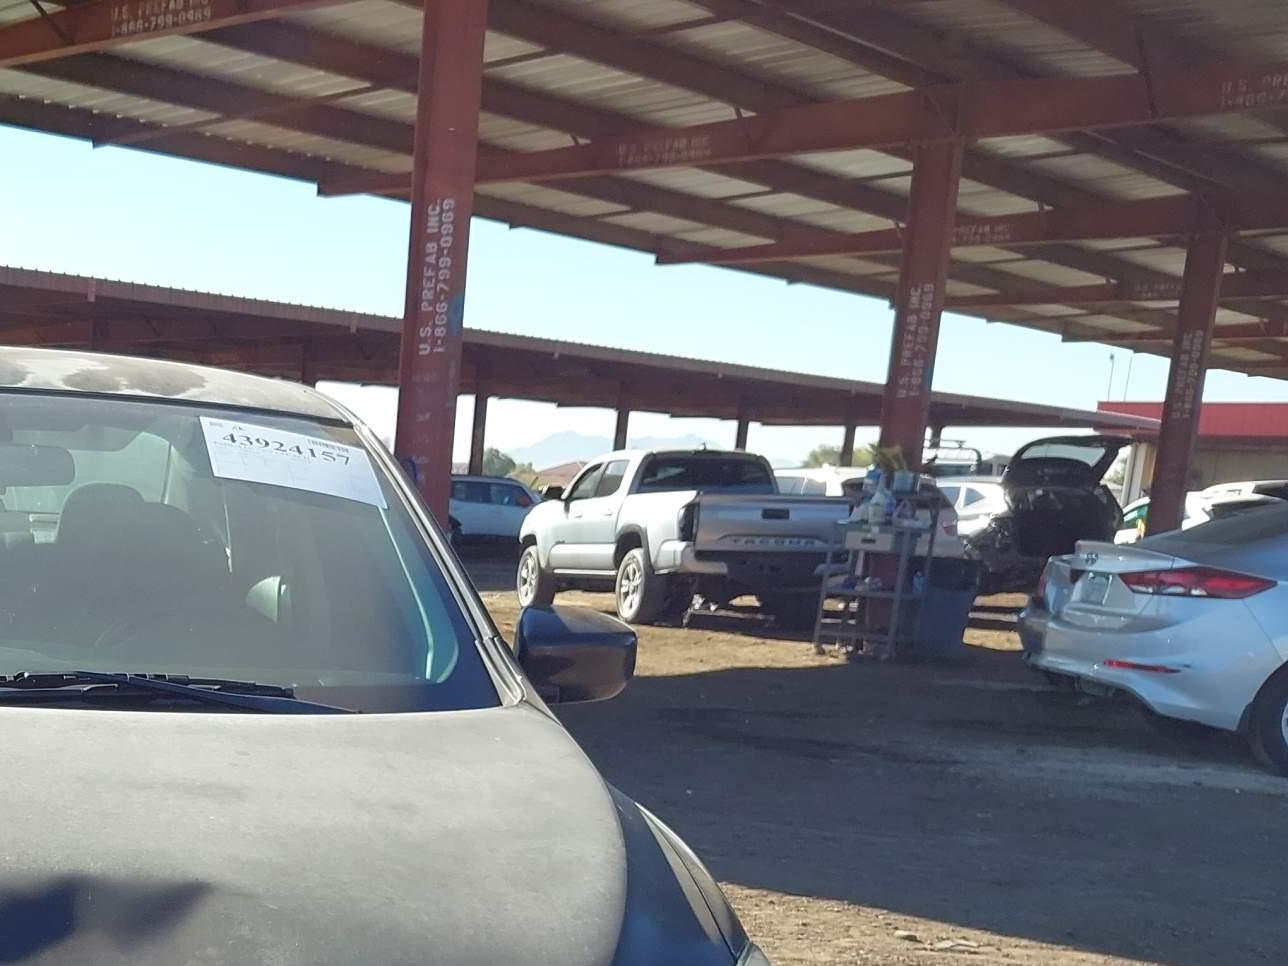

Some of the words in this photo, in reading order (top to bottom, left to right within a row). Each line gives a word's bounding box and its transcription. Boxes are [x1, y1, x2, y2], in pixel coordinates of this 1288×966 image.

[427, 198, 442, 235] INC.
[421, 241, 439, 313] PREFAB
[433, 198, 456, 353] 1-866-799-0969
[418, 320, 434, 356] U.S.
[900, 313, 918, 367] PREFAB
[222, 432, 351, 465] 43924157
